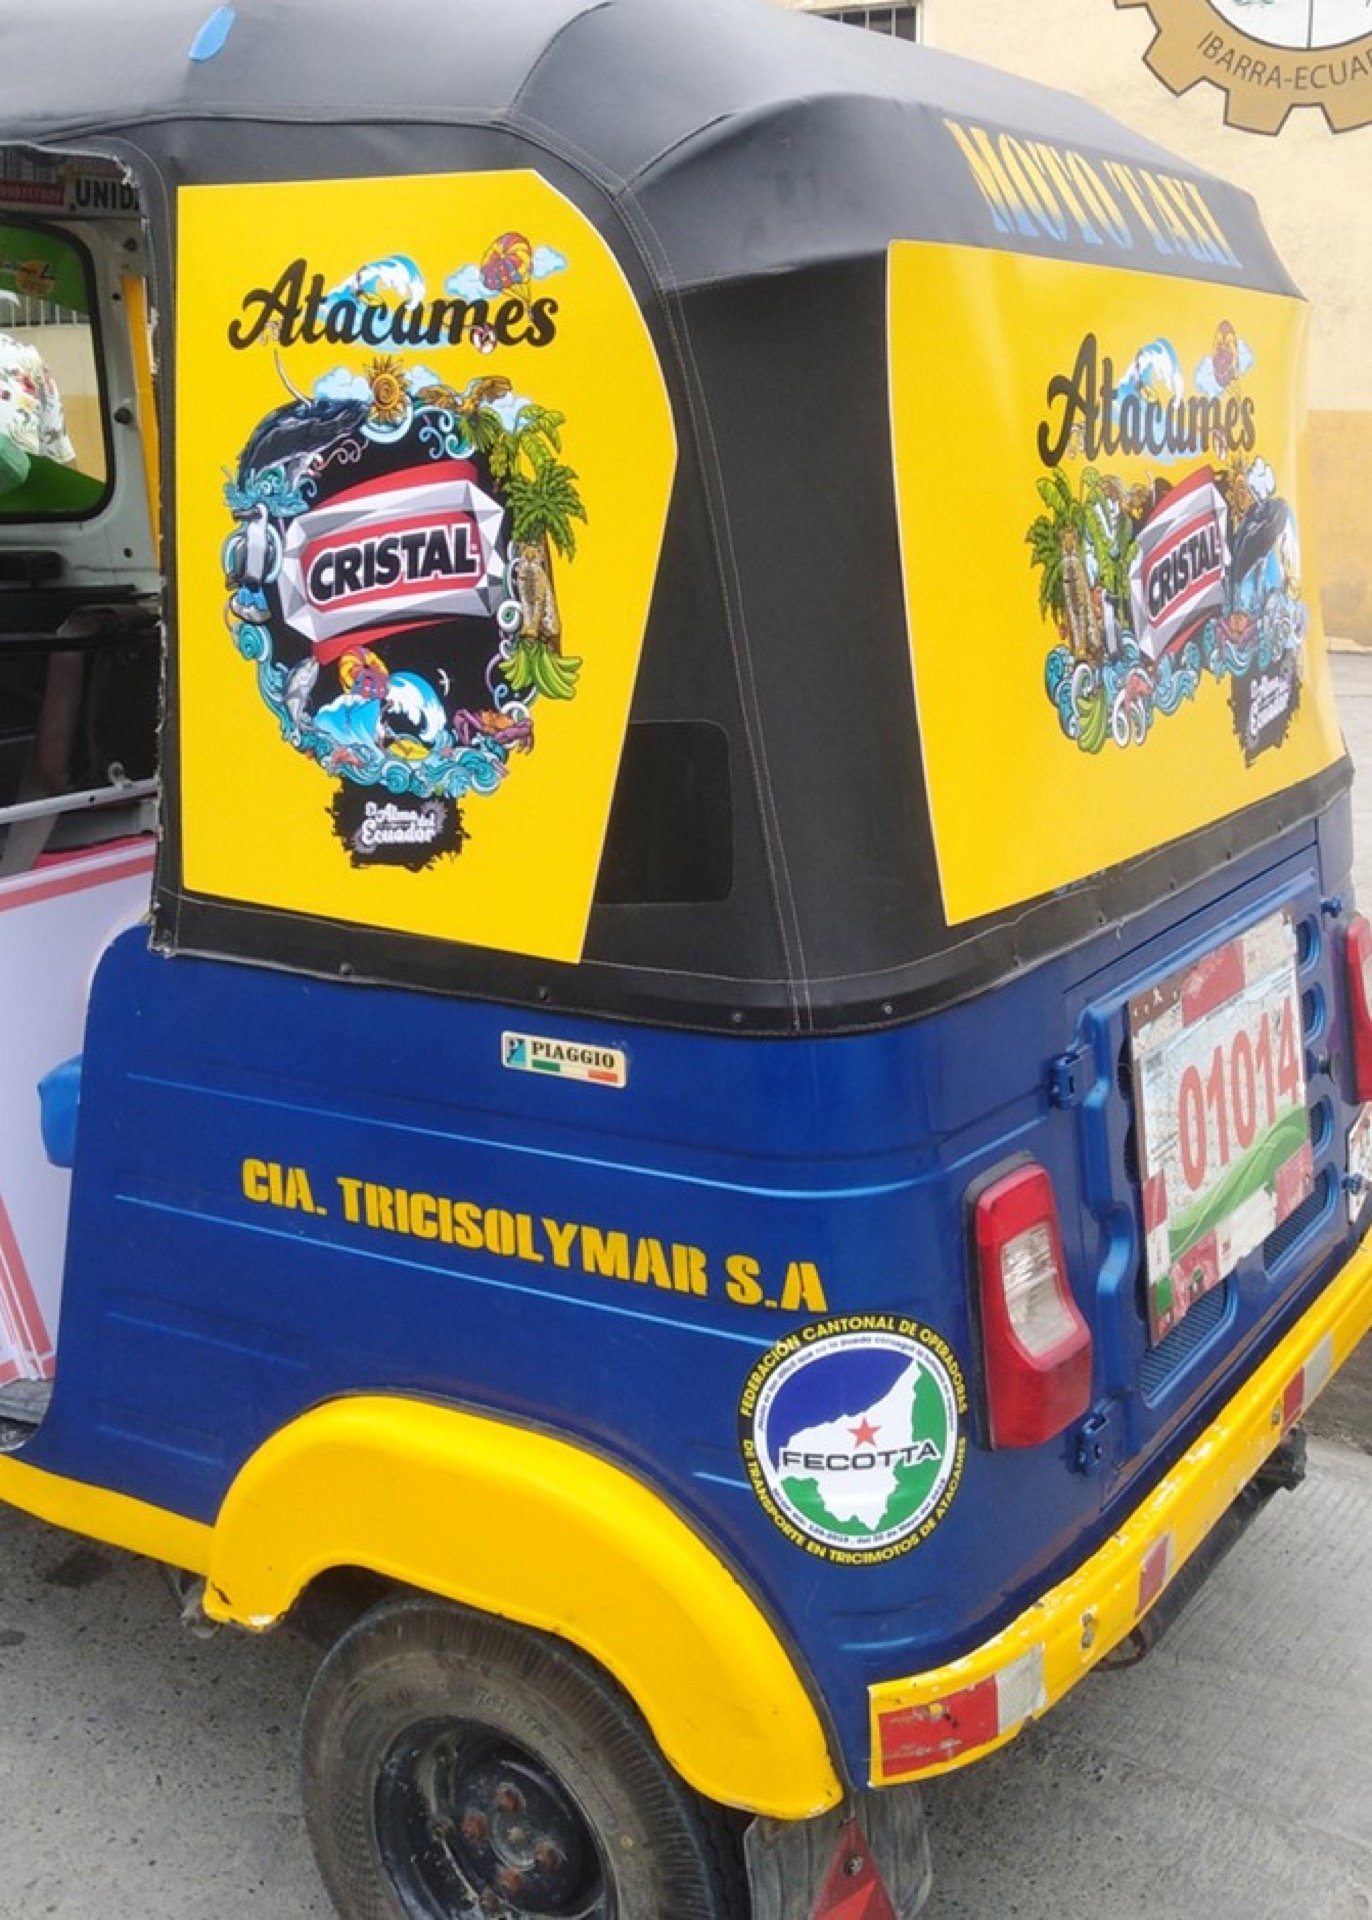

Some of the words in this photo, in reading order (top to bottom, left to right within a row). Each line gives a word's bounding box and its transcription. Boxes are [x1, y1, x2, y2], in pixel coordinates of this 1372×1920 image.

[75, 179, 140, 211] UNID
[942, 117, 1134, 249] MOTO
[1101, 159, 1242, 269] TAXI
[228, 257, 559, 350] Atacames
[1037, 332, 1255, 467] Atacames
[308, 525, 478, 602] CRISTAL
[1149, 525, 1221, 619] CRISTAL
[531, 1041, 615, 1069] PIAGGIO
[1177, 995, 1300, 1192] 01014
[242, 1158, 328, 1216] CIA.
[335, 1176, 708, 1297] TRICISOLYMAR
[725, 1254, 829, 1312] S.A
[740, 1333, 801, 1418] FEDERACIÓN
[802, 1315, 895, 1341] CANTONAL
[898, 1318, 919, 1336] DE
[743, 1438, 757, 1458] DE
[782, 1440, 938, 1471] FECOTTA
[935, 1436, 966, 1519] ATACAMES
[747, 1461, 805, 1547] TRANSPORTE
[919, 1516, 938, 1538] DE
[804, 1540, 827, 1557] EN
[828, 1534, 919, 1565] TRICIMOTOS
